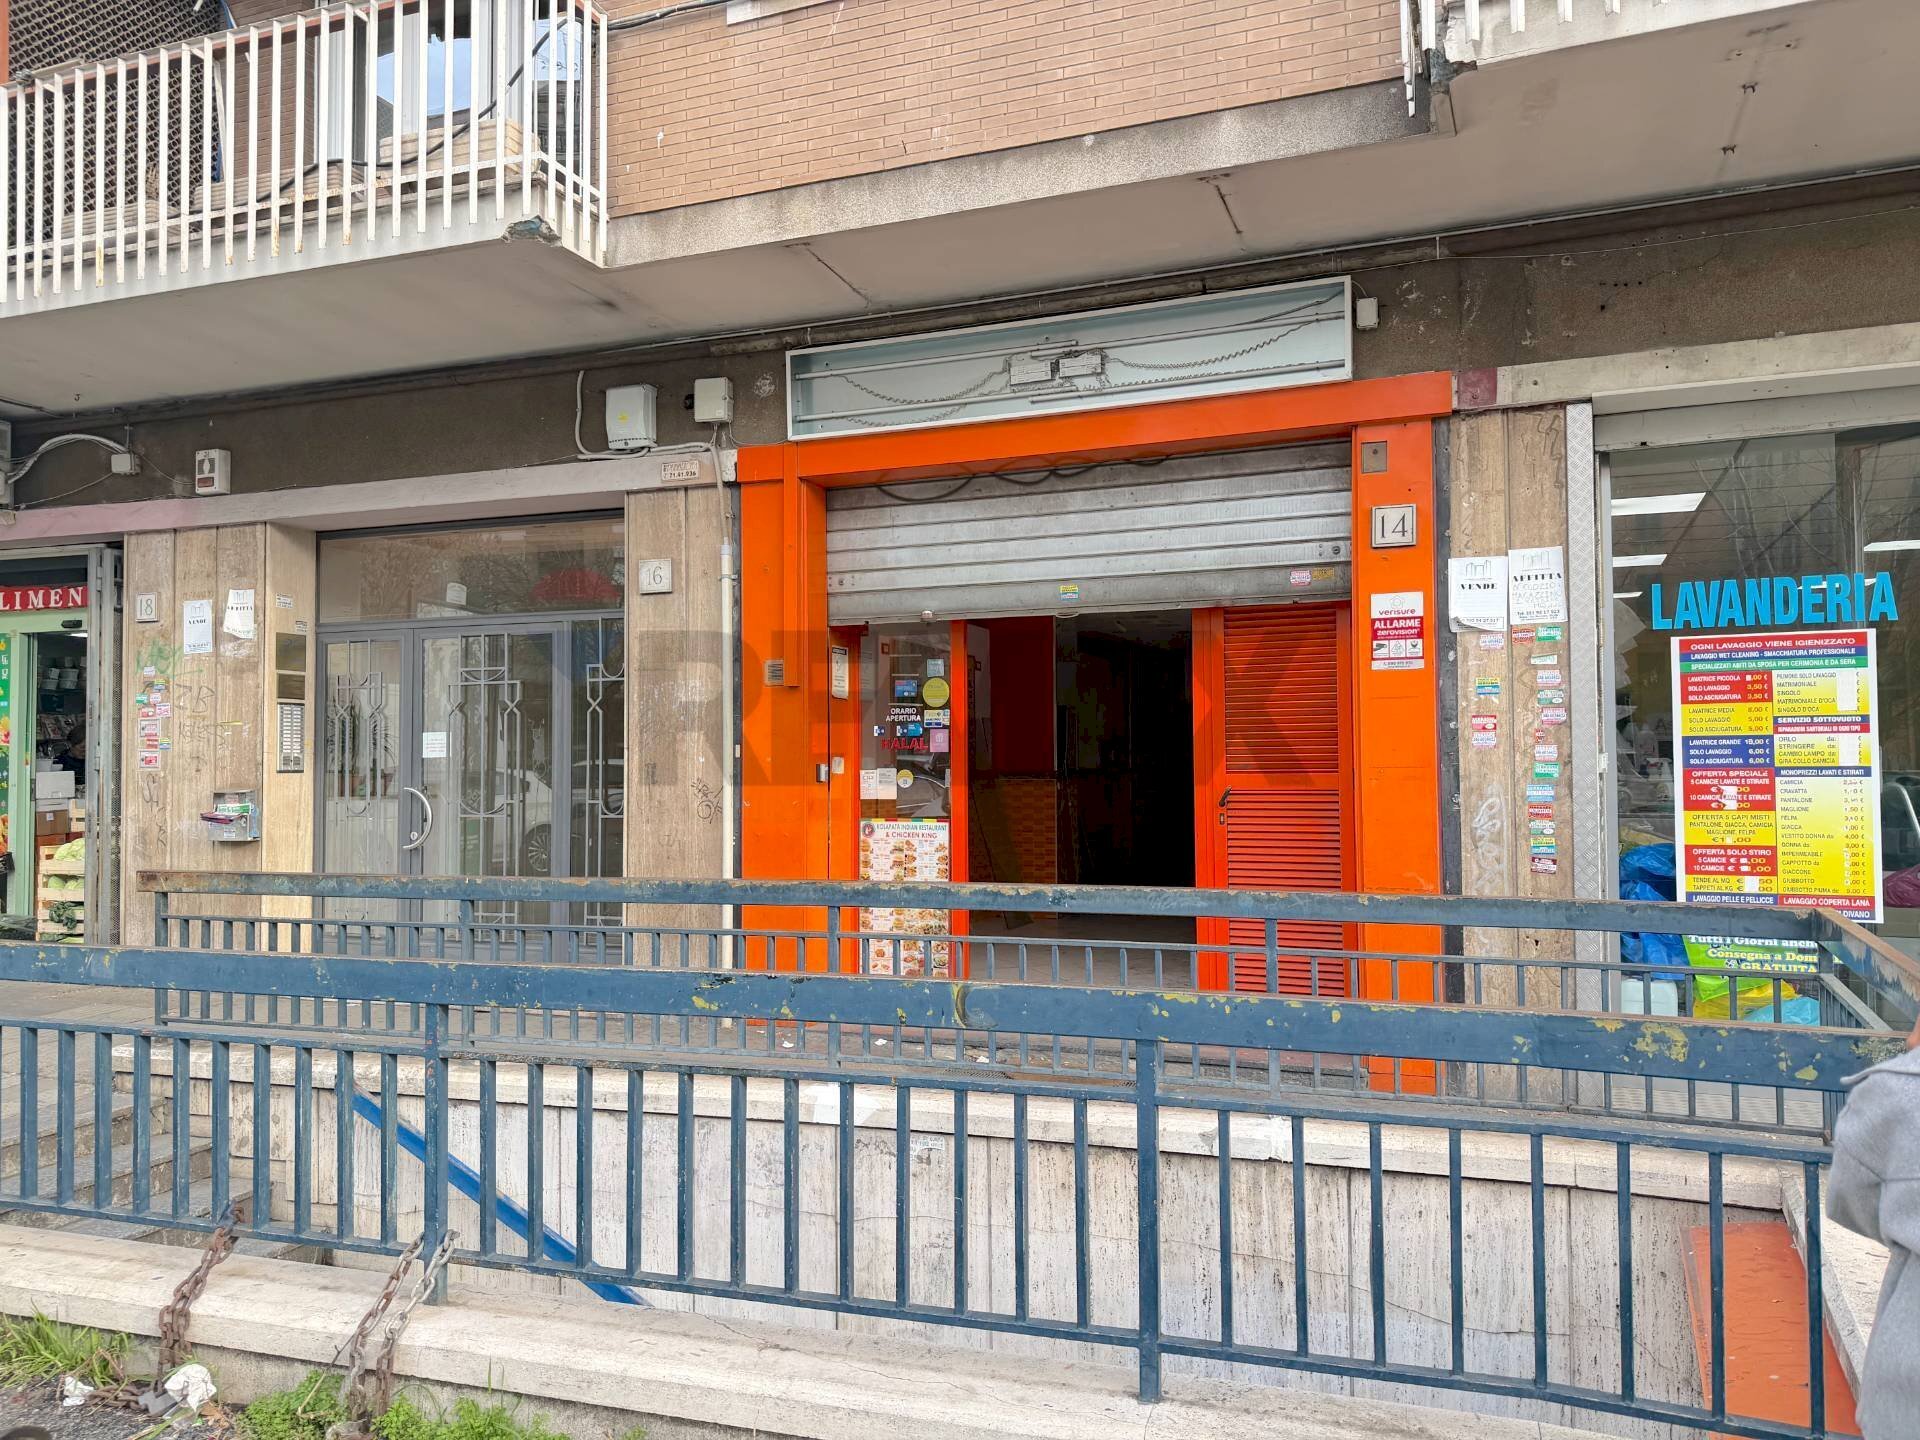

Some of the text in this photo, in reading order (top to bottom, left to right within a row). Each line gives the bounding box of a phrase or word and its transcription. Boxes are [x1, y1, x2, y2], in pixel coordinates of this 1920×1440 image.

[1380, 513, 1408, 538] 14
[647, 566, 662, 586] 16
[0, 586, 84, 610] LIMEN
[1652, 572, 1899, 630] LAVANDERIA
[140, 598, 153, 616] 18
[1374, 619, 1422, 629] ALLARME
[882, 738, 928, 750] HALAL
[1688, 935, 1723, 944] Tutti
[1734, 937, 1778, 946] Giorni
[1707, 949, 1771, 960] Consegna
[1740, 963, 1817, 973] GRATUITA
